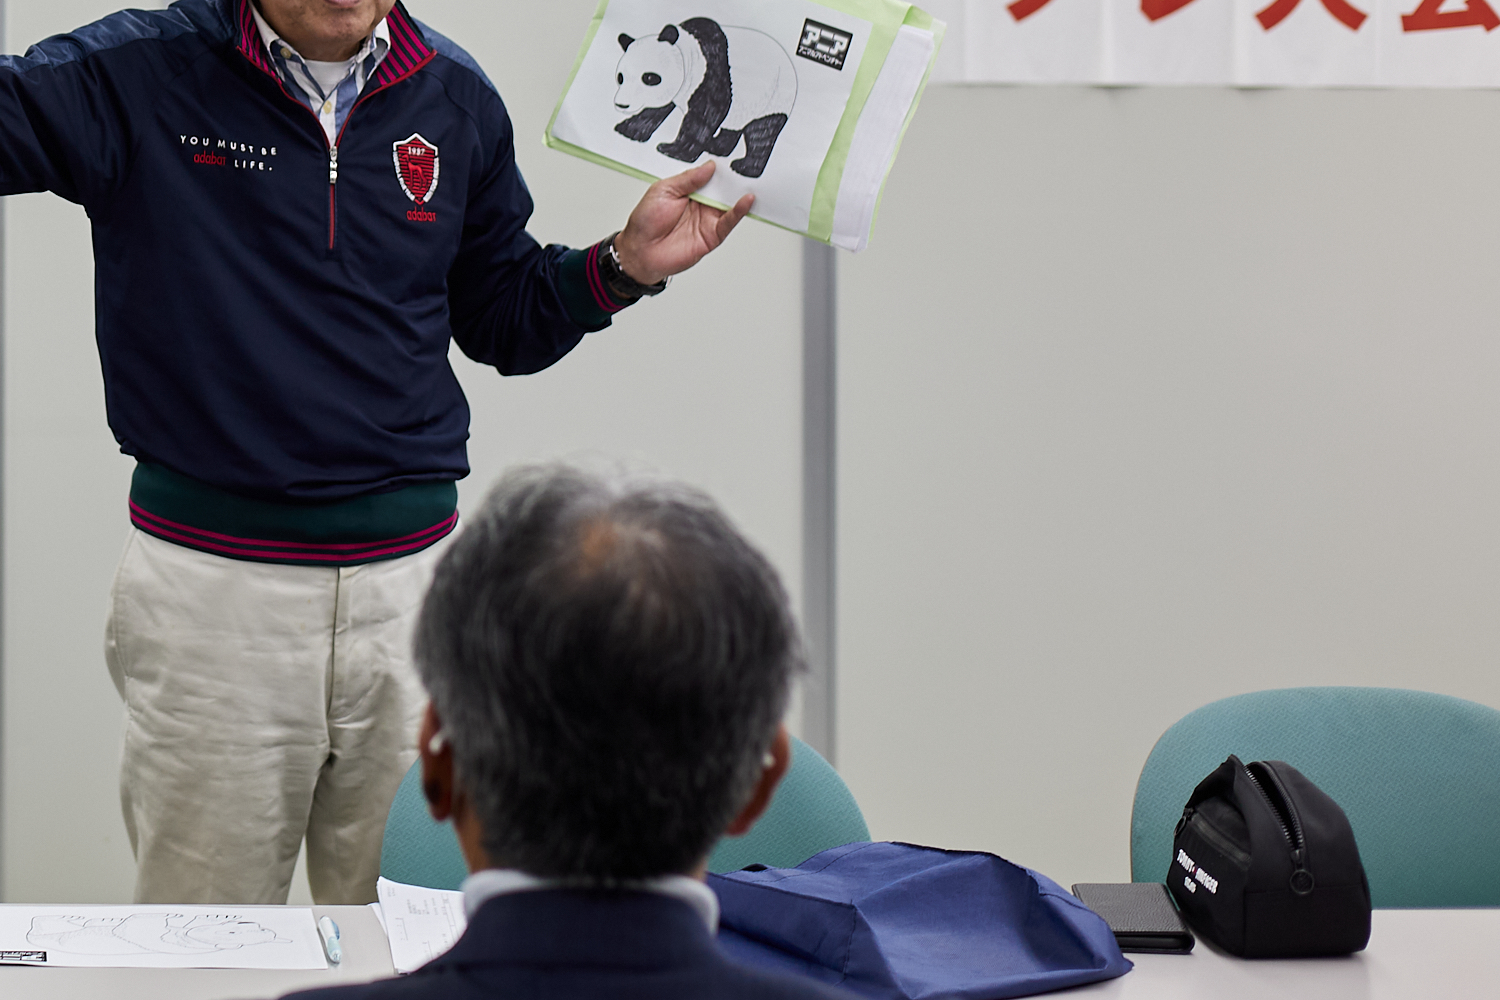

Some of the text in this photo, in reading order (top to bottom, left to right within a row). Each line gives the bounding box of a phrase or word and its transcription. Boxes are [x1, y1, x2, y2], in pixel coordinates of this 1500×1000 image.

[179, 134, 278, 156] YOU MUST BE
